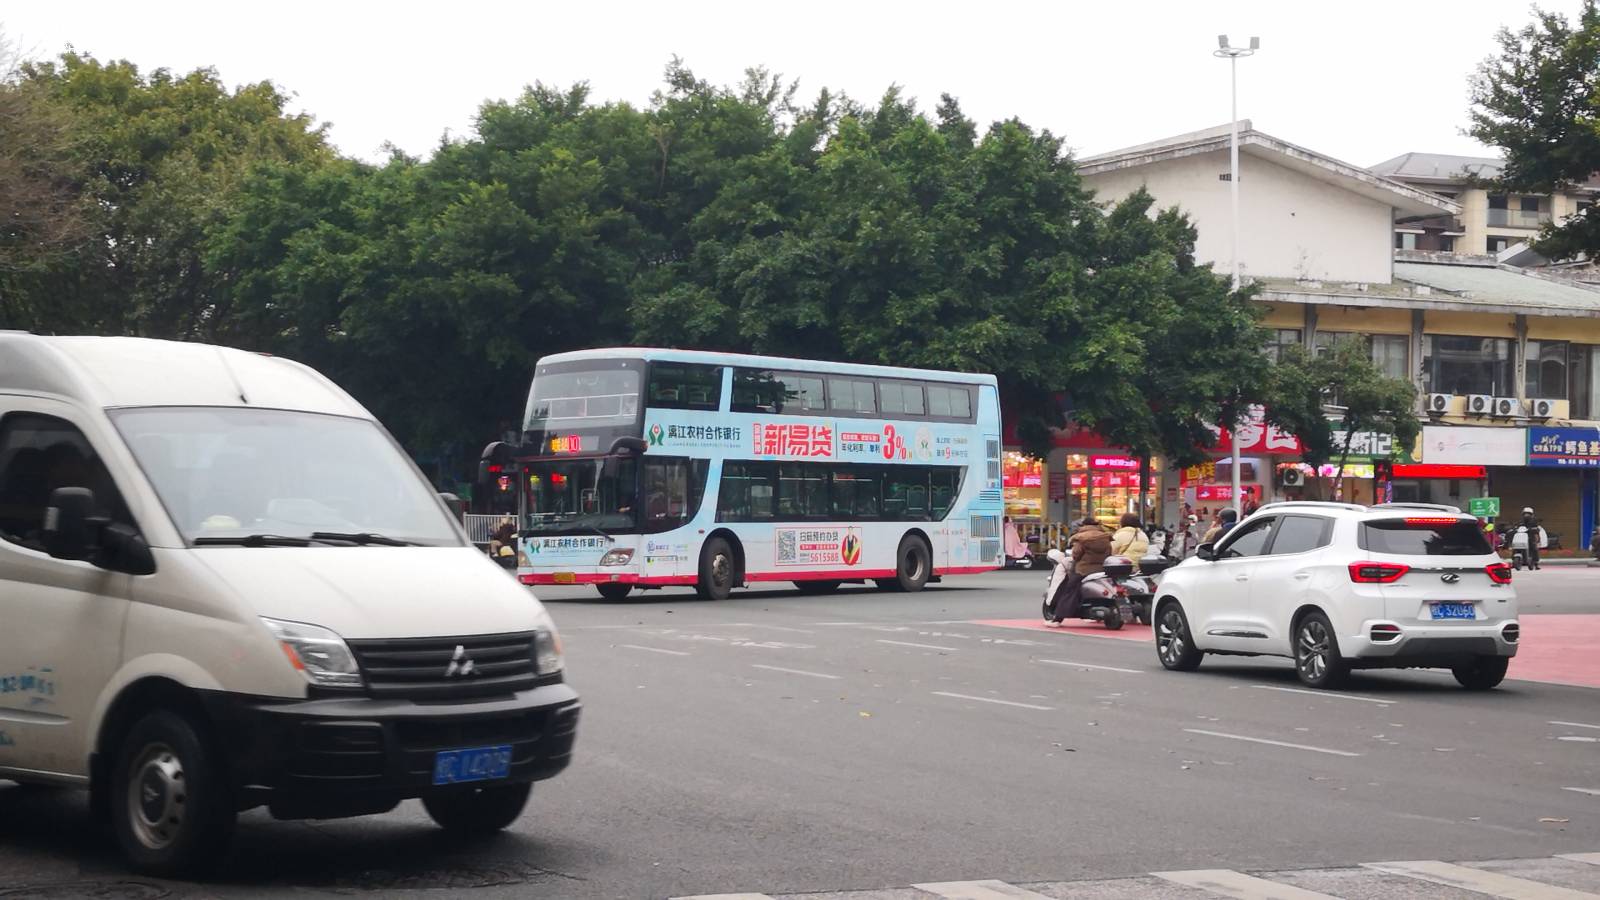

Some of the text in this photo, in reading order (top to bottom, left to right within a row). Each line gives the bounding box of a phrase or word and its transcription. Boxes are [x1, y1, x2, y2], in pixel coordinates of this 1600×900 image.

[668, 425, 741, 440] 漓江农村合作银行
[764, 424, 832, 456] 新易贷
[543, 537, 605, 549] 漓江农村合作银行
[800, 531, 839, 542] 扫码预约办贷
